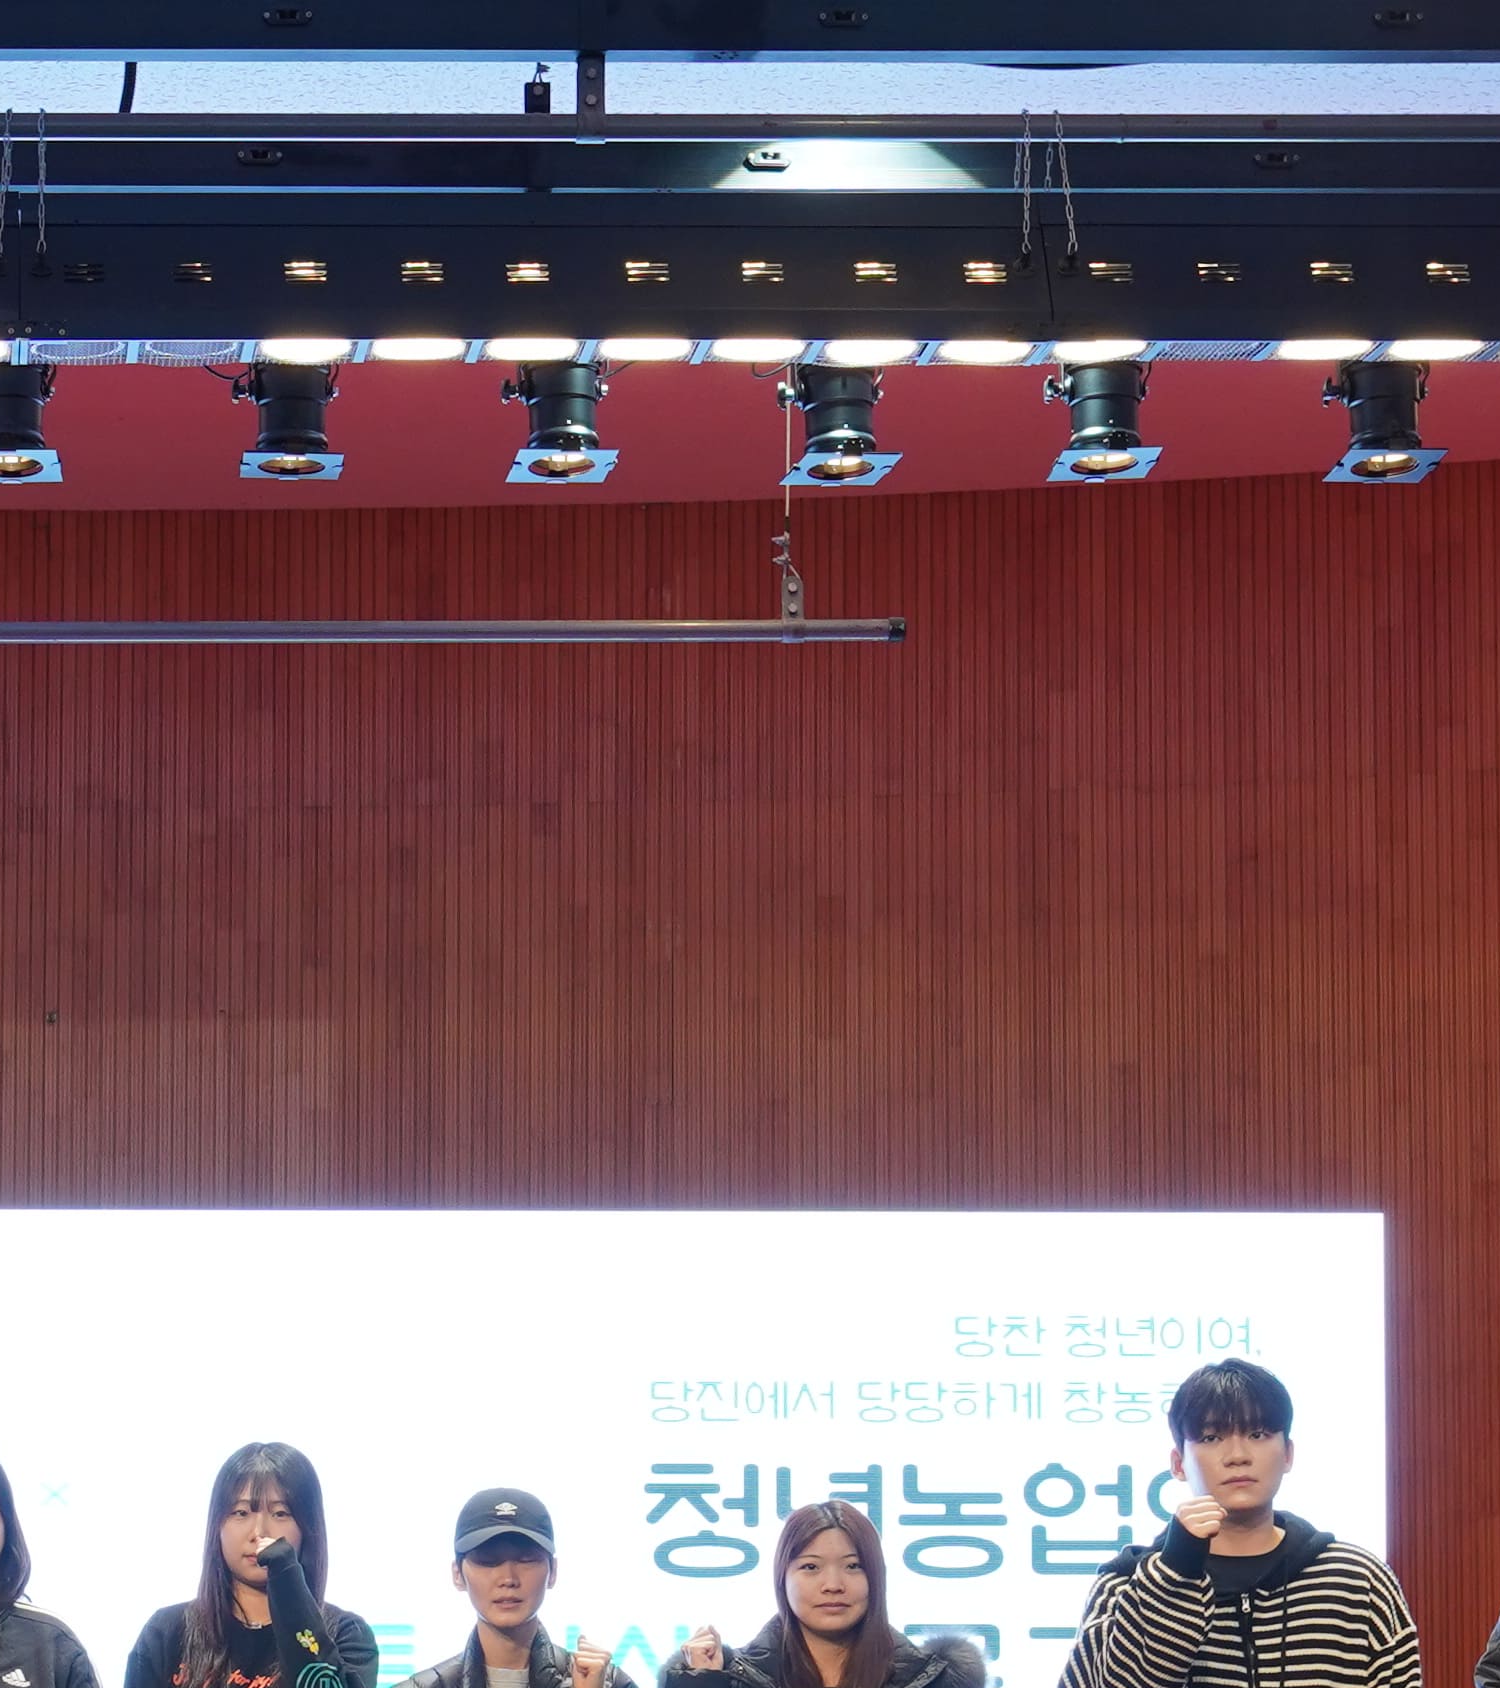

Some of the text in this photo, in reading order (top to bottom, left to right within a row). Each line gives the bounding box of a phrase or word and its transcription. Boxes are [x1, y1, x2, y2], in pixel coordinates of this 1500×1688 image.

[954, 1315, 1263, 1358] 당찬 청년이여,
[649, 1380, 836, 1423] 당진에서
[857, 1380, 1042, 1423] 당당하게
[643, 1462, 1176, 1580] 청년농업
